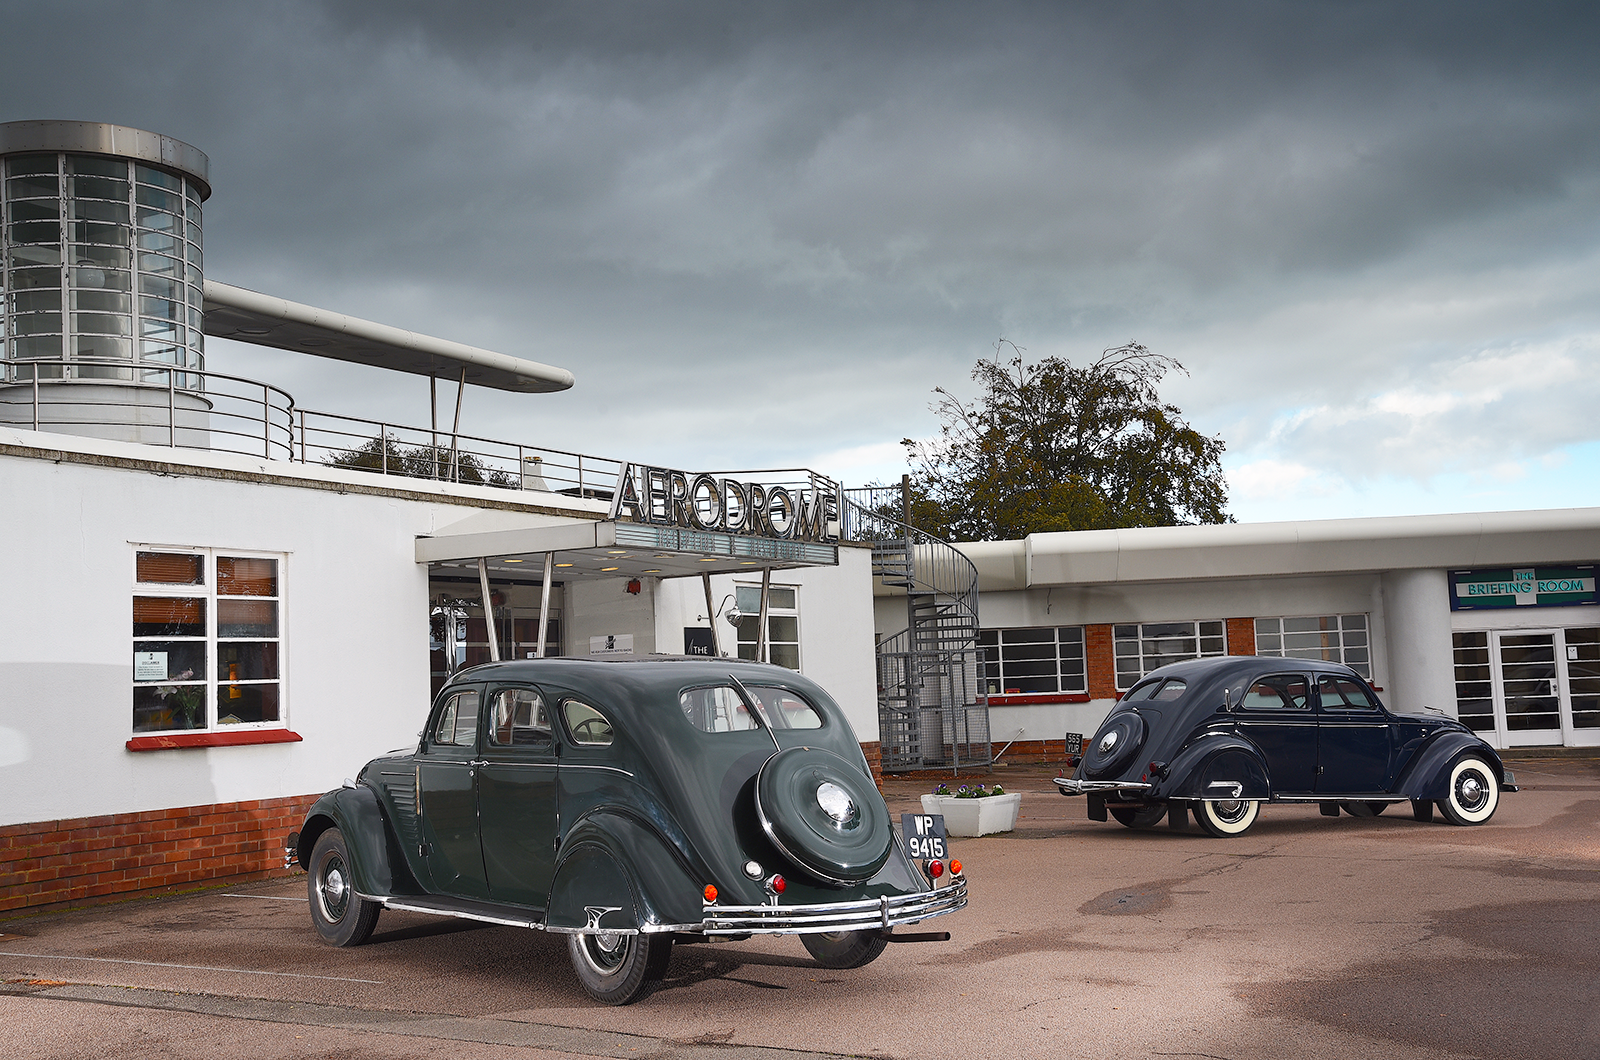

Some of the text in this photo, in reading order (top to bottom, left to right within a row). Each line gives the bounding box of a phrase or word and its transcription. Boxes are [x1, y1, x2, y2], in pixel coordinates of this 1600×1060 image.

[608, 461, 839, 543] AERODROME
[1515, 572, 1534, 580] THE
[1468, 580, 1584, 595] BRIEFING ROOM
[693, 646, 708, 655] THE
[1068, 734, 1080, 744] 565
[1067, 743, 1080, 753] YUR
[914, 815, 934, 836] WP
[910, 837, 944, 858] 9415
